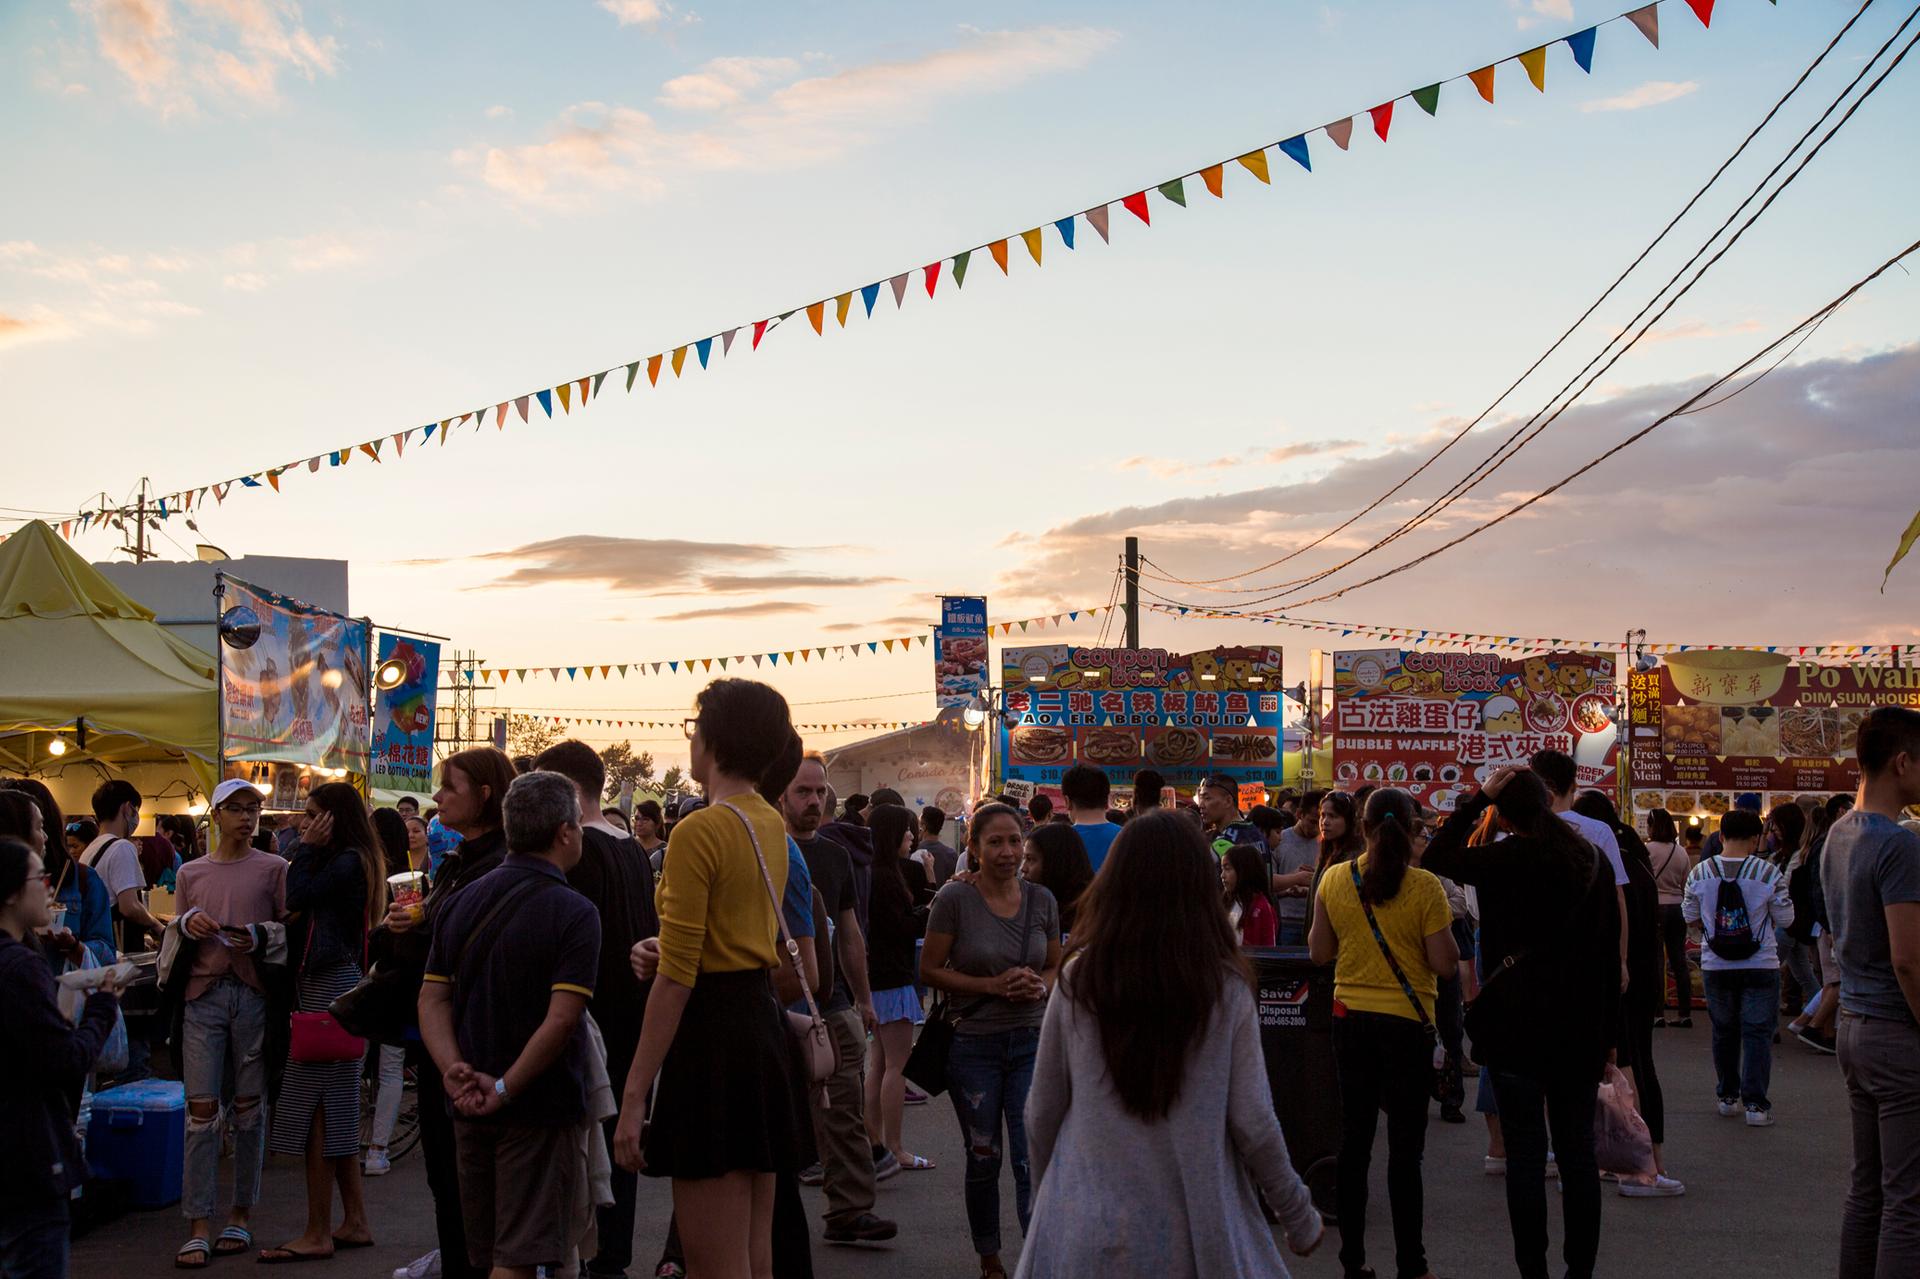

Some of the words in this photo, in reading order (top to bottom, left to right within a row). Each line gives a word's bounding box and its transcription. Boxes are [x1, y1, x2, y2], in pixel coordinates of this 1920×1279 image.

[1073, 648, 1169, 671] coupon
[1405, 653, 1501, 676] coupon
[1111, 668, 1169, 688] book
[1796, 660, 1841, 688] Po
[1847, 660, 1920, 689] Wah
[1444, 671, 1502, 692] book
[1595, 684, 1612, 694] F59
[1006, 691, 1250, 713] 老二驰名铁板鱿鱼
[1801, 692, 1832, 704] DIM
[1836, 692, 1871, 704] SUM
[1876, 692, 1920, 705] HOUS
[1260, 701, 1277, 711] F58
[1022, 713, 1052, 725] AO
[1070, 713, 1097, 725] ER
[1113, 713, 1160, 726] BBQ
[1176, 713, 1247, 726] SQUID
[1340, 701, 1478, 729] 古法雞蛋仔
[1335, 738, 1392, 750] BUBBLE
[1397, 739, 1456, 751] WAFFLE
[1633, 748, 1661, 760] Free
[376, 764, 386, 775] LED
[1577, 765, 1605, 777] RDER
[1632, 760, 1664, 771] Chow
[1634, 771, 1662, 781] Mein
[1006, 782, 1030, 791] ORDER
[1260, 988, 1293, 999] Save
[1259, 1004, 1301, 1017] Disposal
